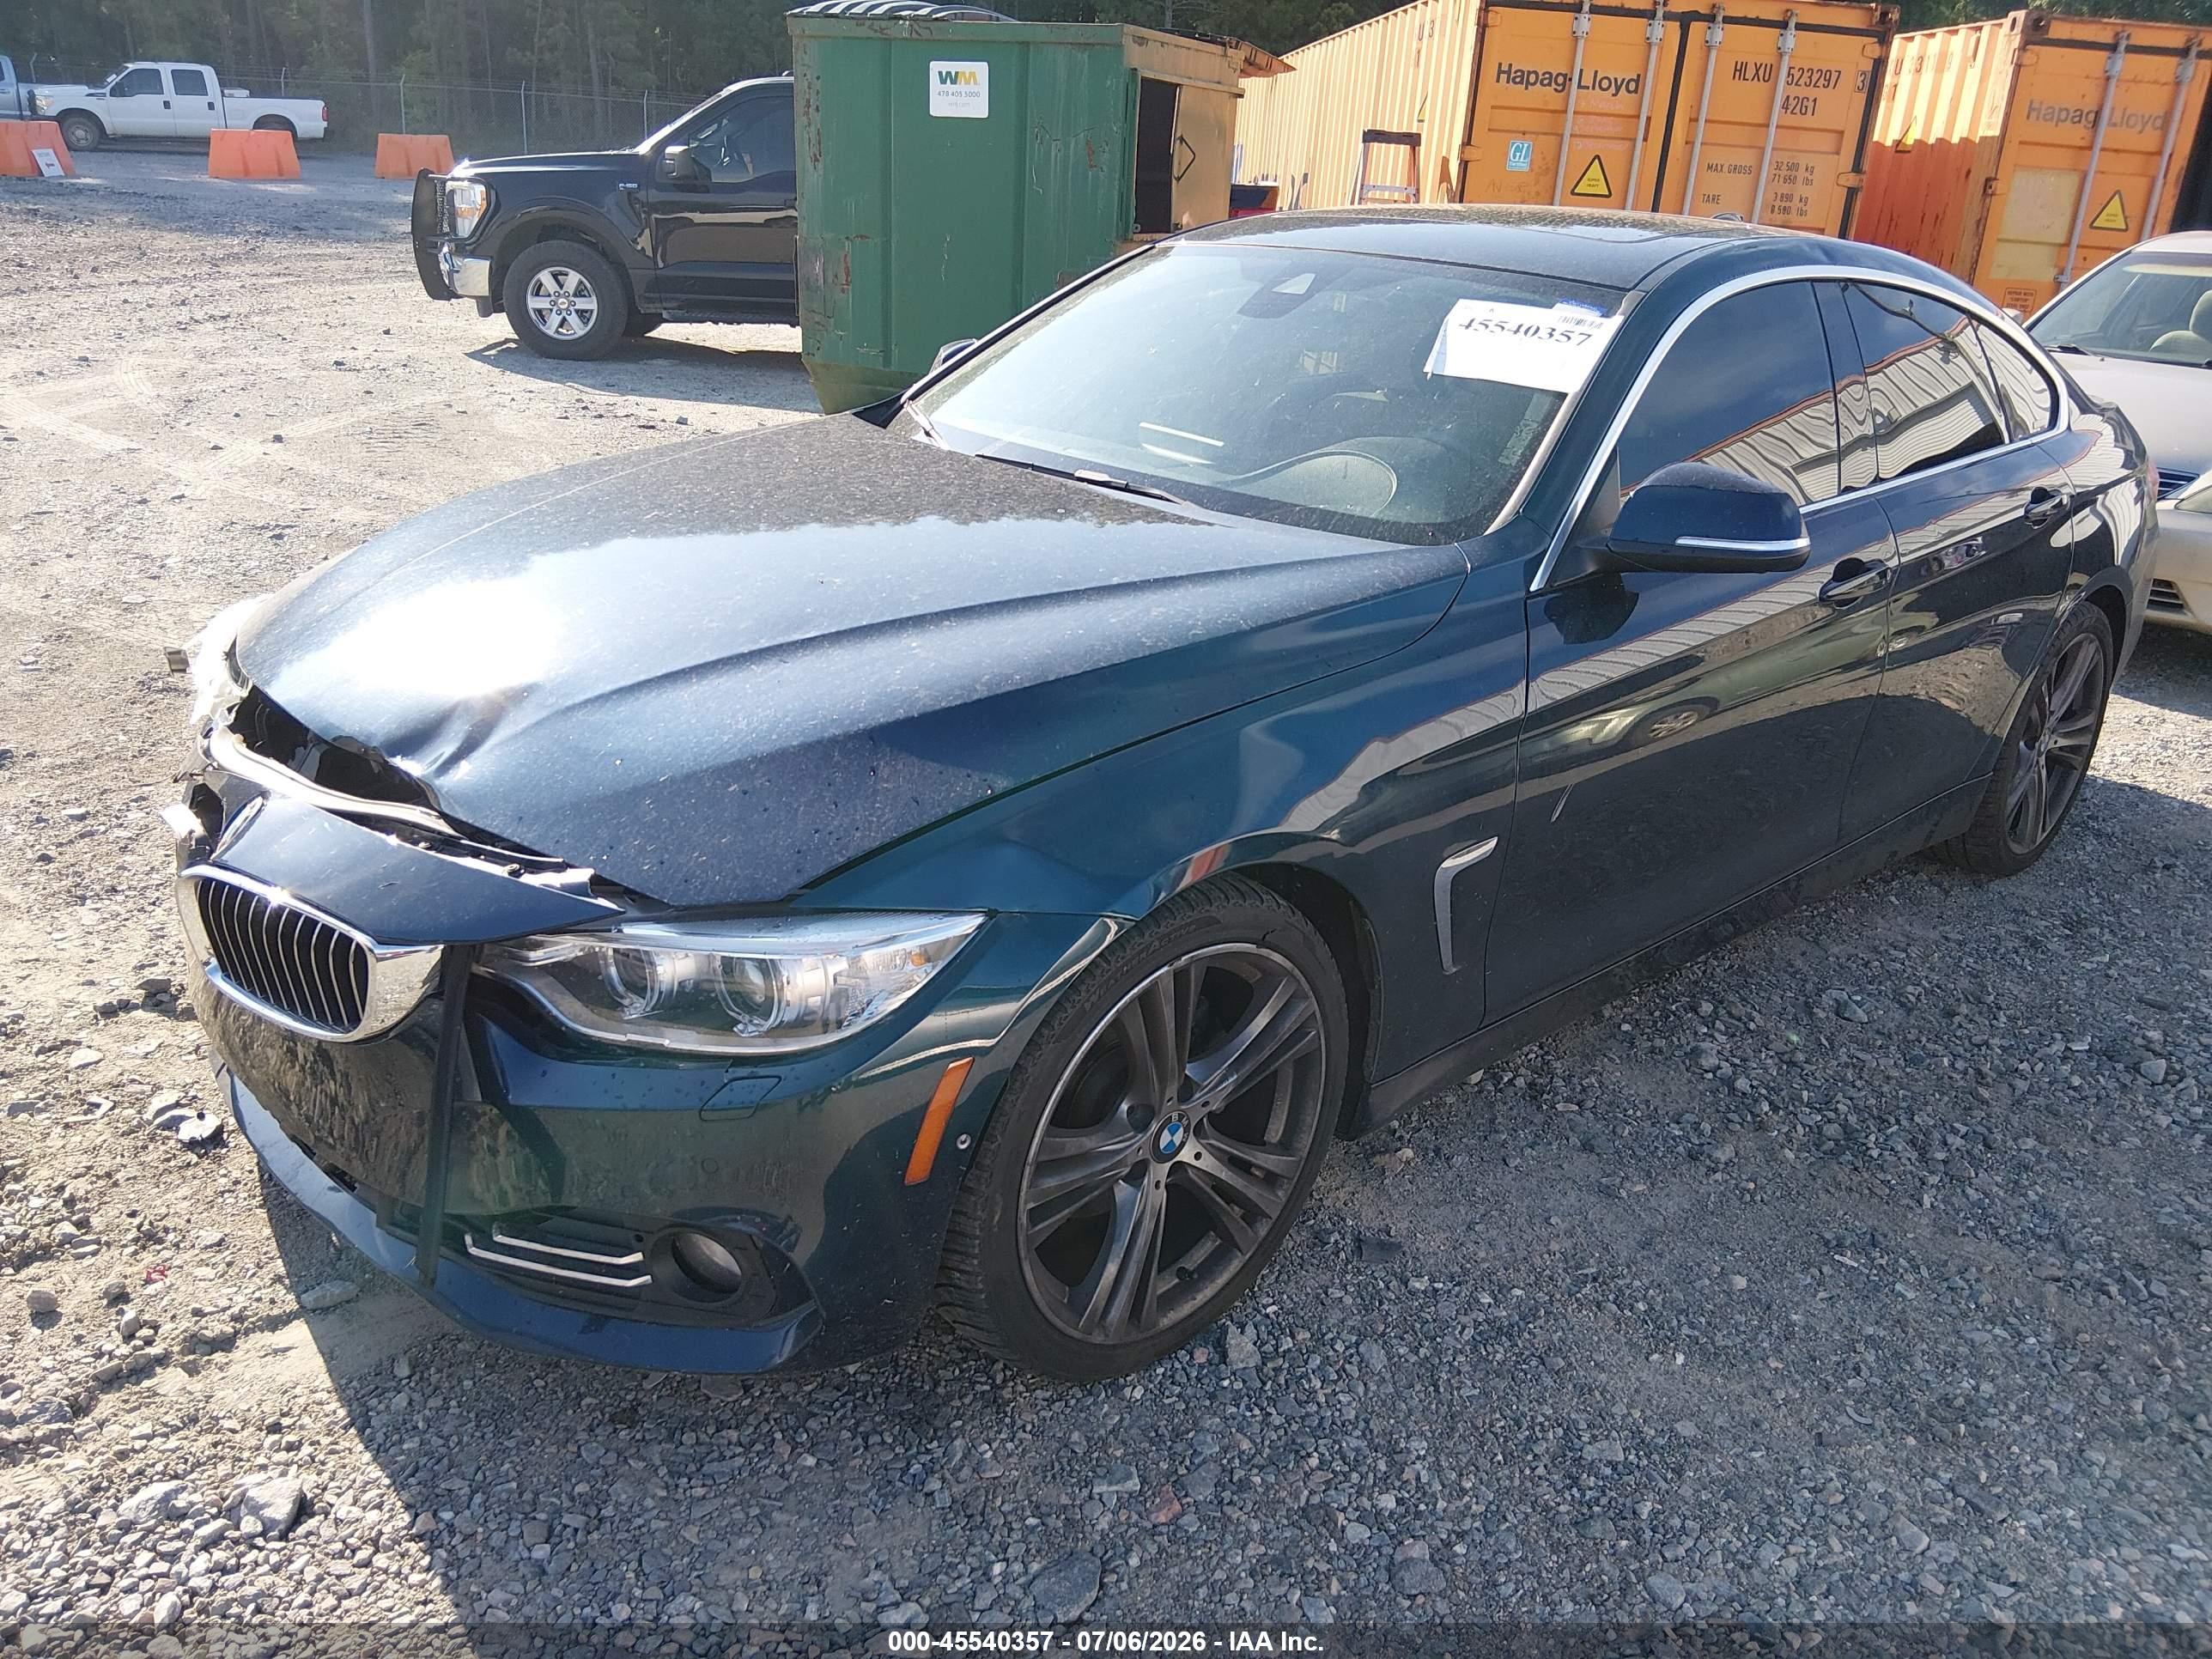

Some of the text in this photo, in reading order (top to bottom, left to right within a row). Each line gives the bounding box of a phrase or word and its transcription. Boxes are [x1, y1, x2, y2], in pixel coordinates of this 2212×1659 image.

[938, 70, 978, 85] WM
[1732, 61, 1868, 91] HLXU 523297 3
[1782, 94, 1818, 117] 42G1
[2026, 98, 2168, 135] HapagLloyd
[1510, 143, 1529, 162] GL
[1728, 164, 1753, 175] GROSS
[1805, 164, 1814, 176] kg
[1802, 176, 1814, 186] lbs
[1702, 193, 1721, 204] TARE
[1799, 194, 1808, 206] kg
[1796, 206, 1808, 217] lbs
[1459, 318, 1595, 346] 45540357
